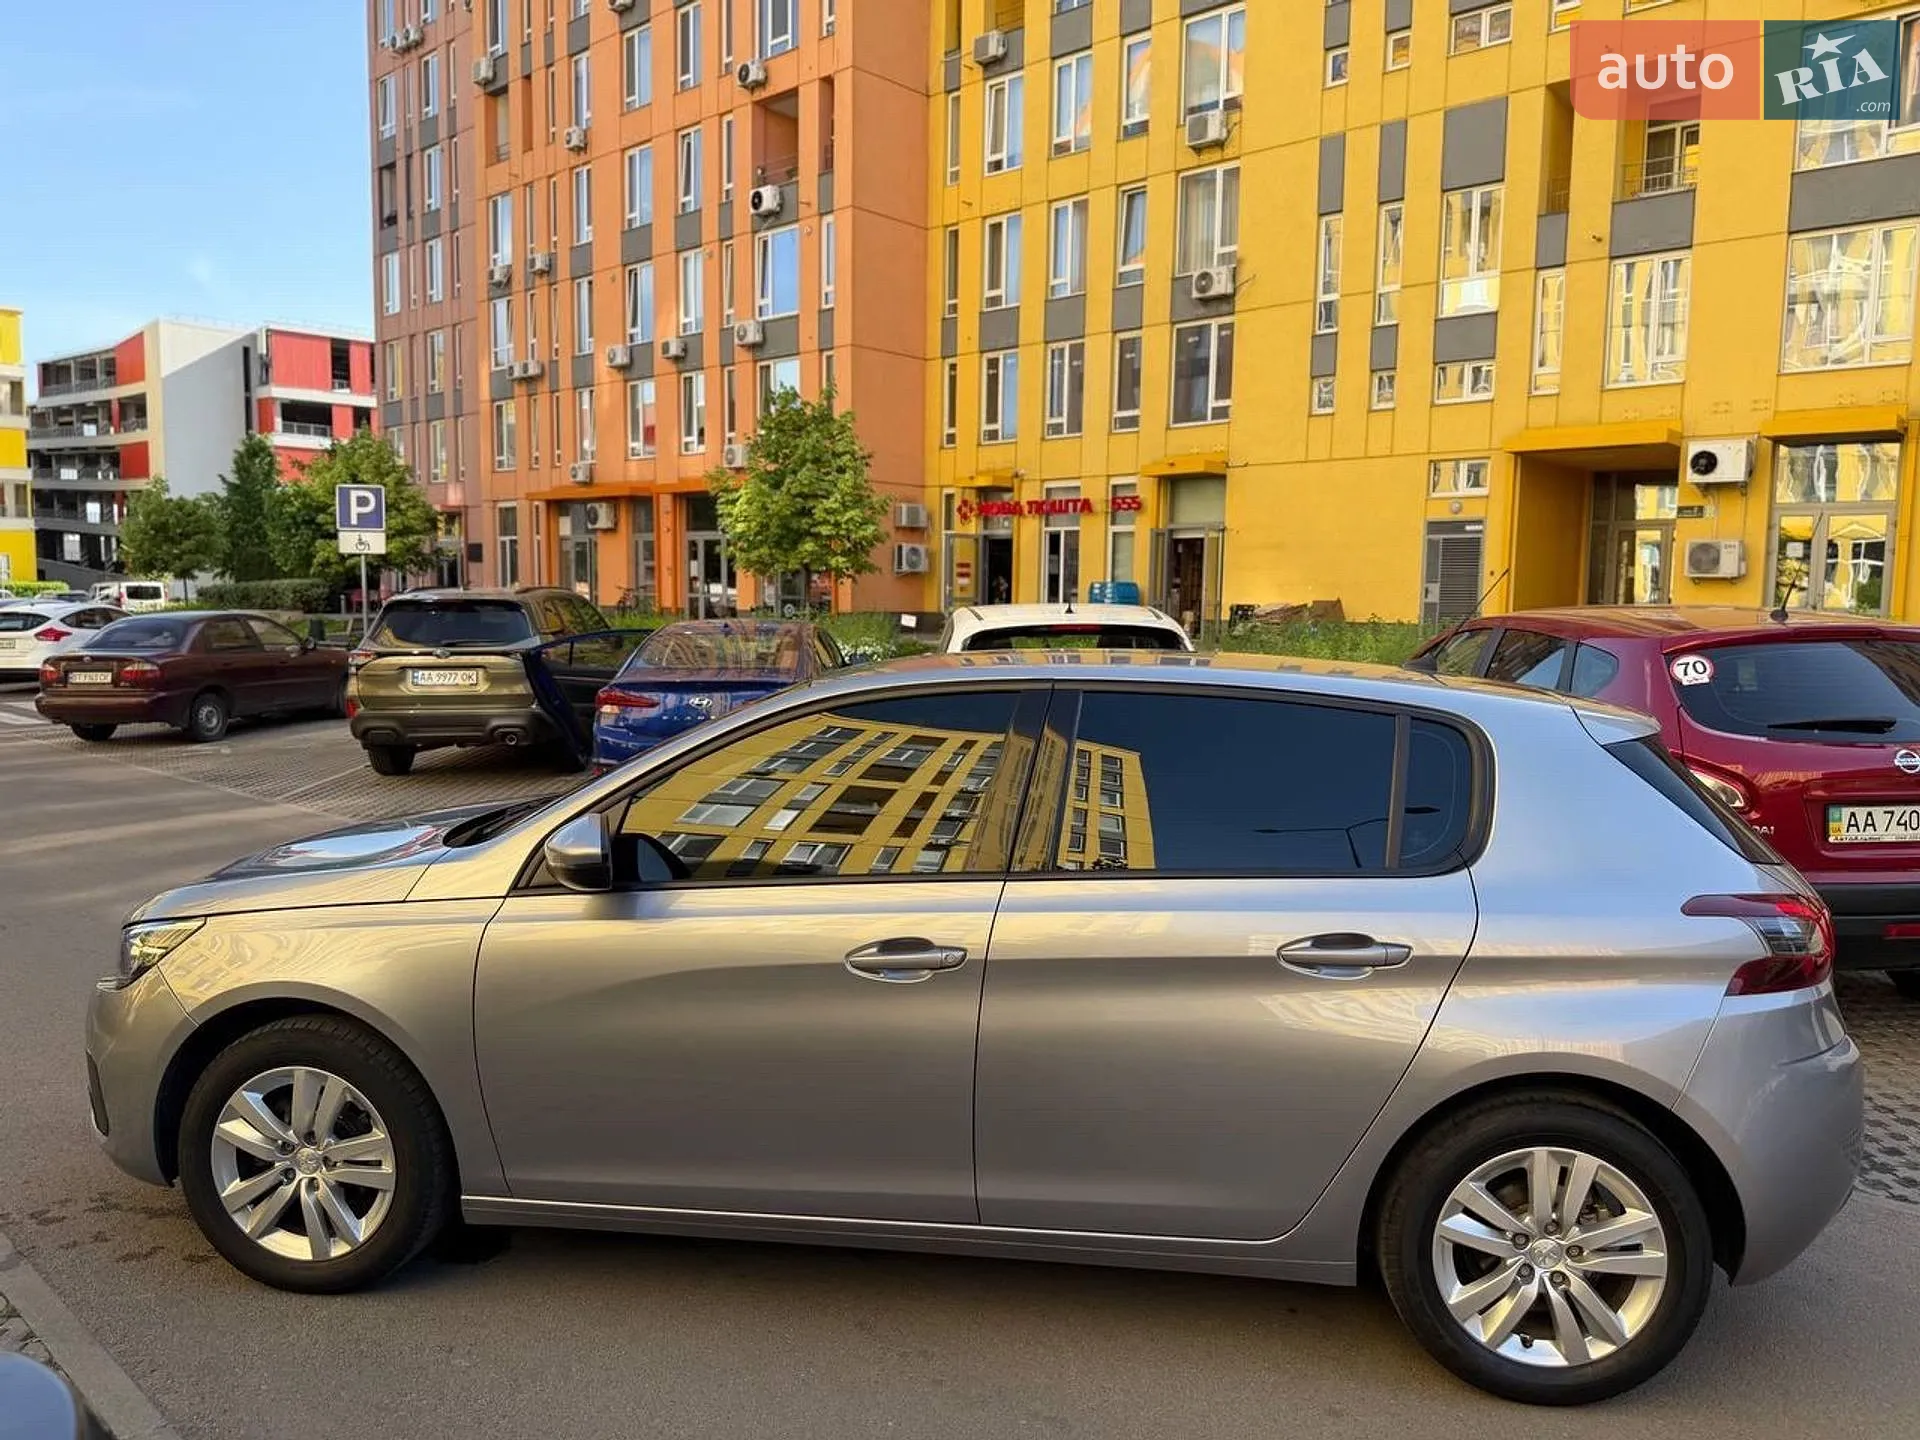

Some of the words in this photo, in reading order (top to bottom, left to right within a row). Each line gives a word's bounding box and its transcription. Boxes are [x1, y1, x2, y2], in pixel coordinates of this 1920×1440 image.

[350, 490, 376, 525] P
[1677, 660, 1707, 676] 70
[1846, 811, 1877, 833] AA
